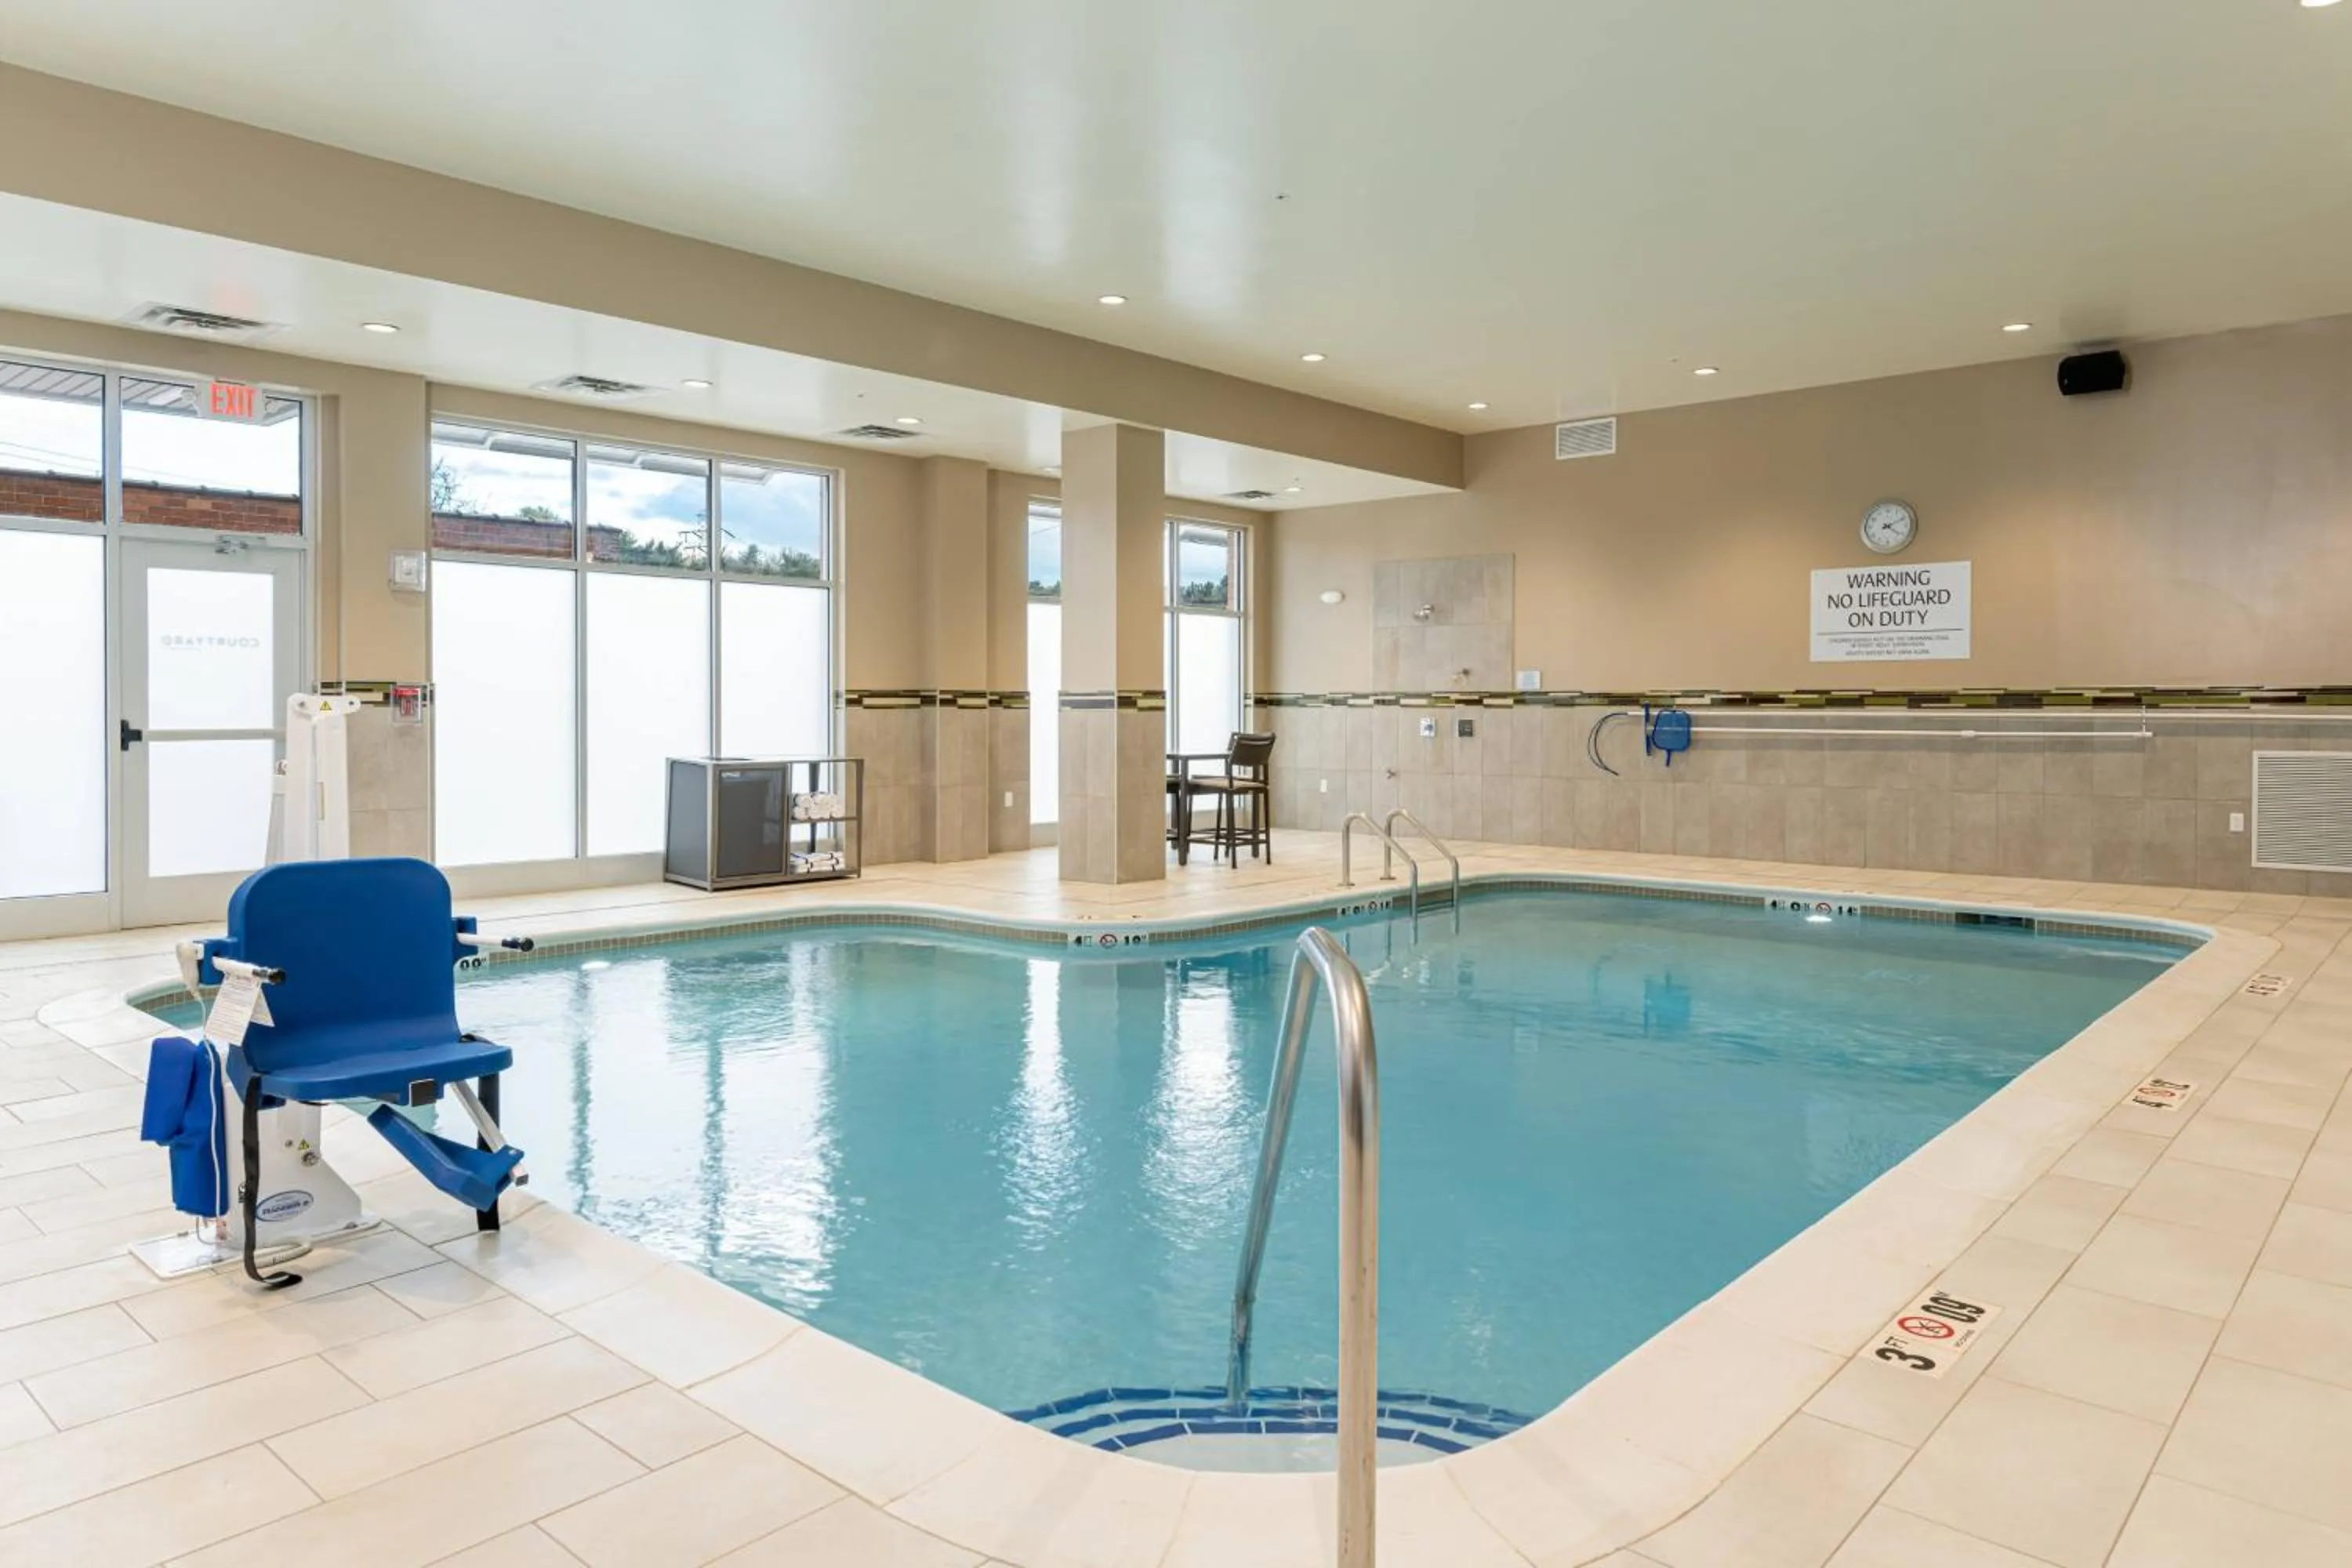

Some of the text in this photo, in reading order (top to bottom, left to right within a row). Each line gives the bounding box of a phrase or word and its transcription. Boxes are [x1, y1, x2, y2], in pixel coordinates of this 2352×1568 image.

[210, 383, 257, 417] EXIT
[1847, 570, 1931, 589] WARNING
[1828, 589, 1951, 609] NO LIFEGUARD
[1848, 610, 1929, 628] ON DUTY
[1875, 1347, 1936, 1371] 3
